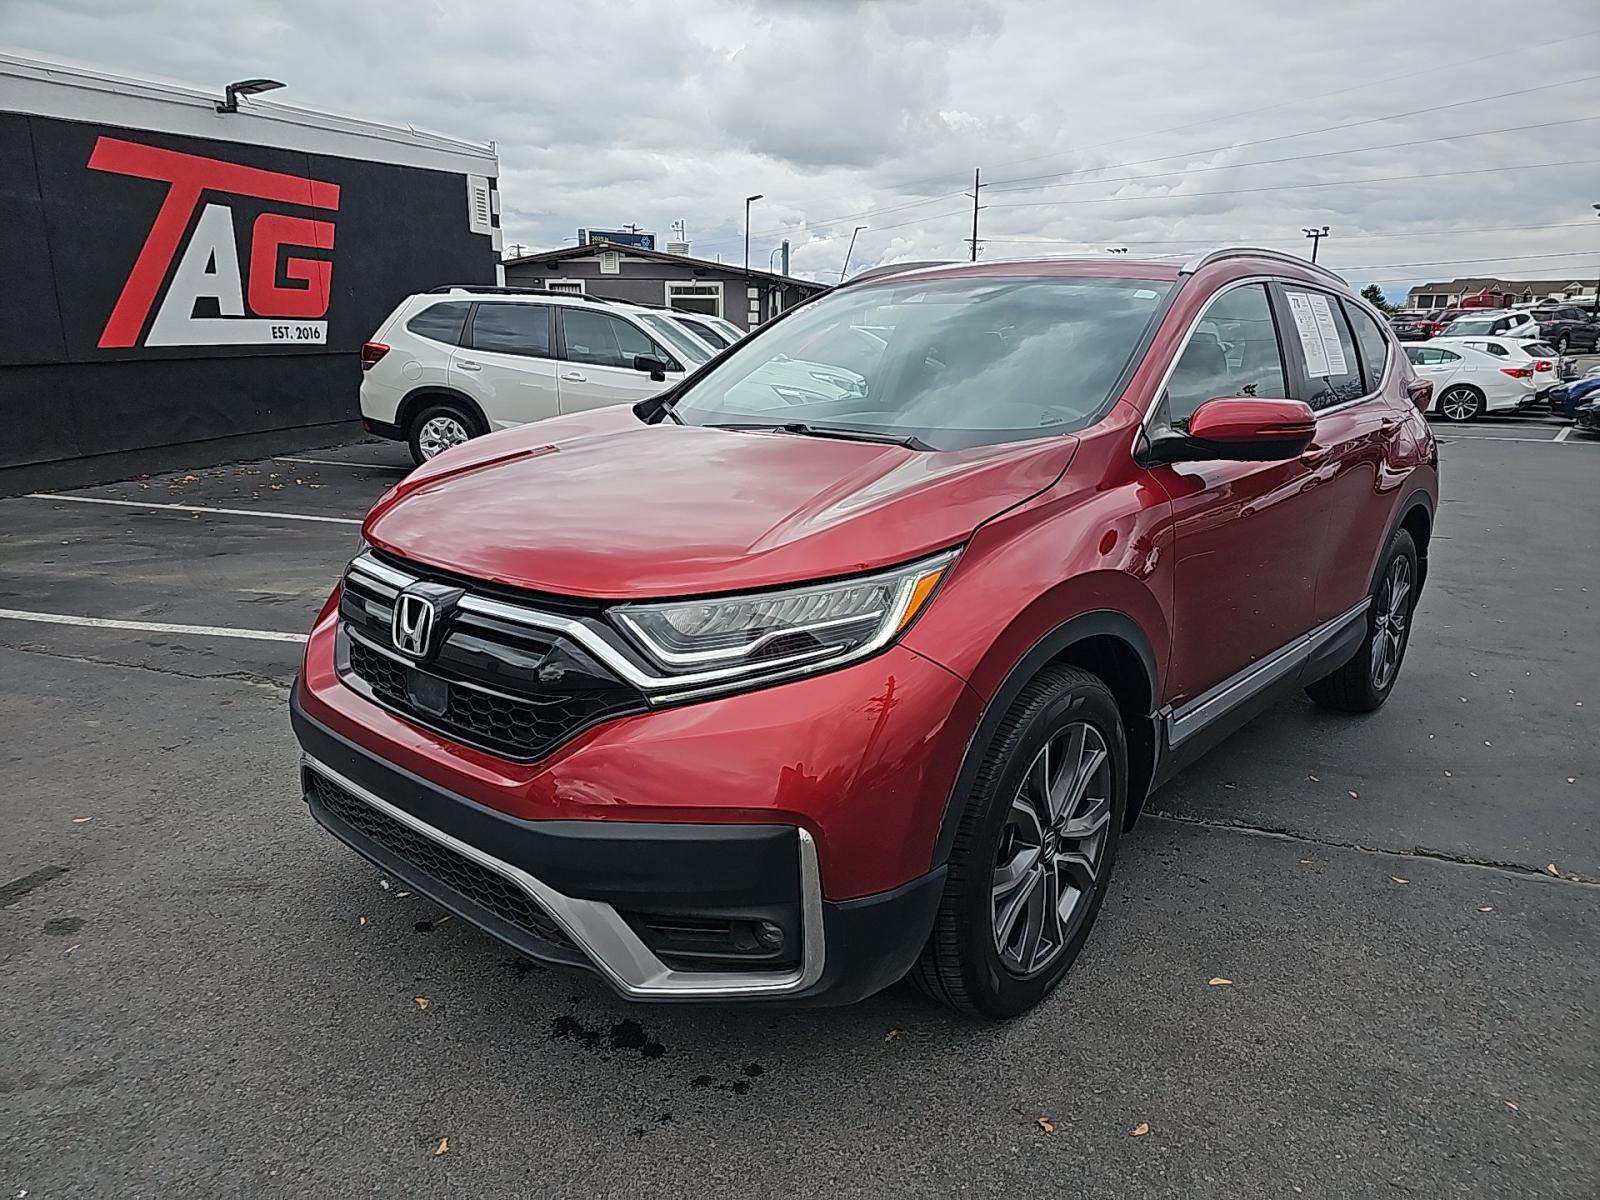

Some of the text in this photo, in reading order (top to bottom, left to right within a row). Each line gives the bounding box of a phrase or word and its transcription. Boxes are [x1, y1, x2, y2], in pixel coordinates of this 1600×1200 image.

[87, 135, 341, 348] TAG
[271, 326, 321, 340] EST. 2016
